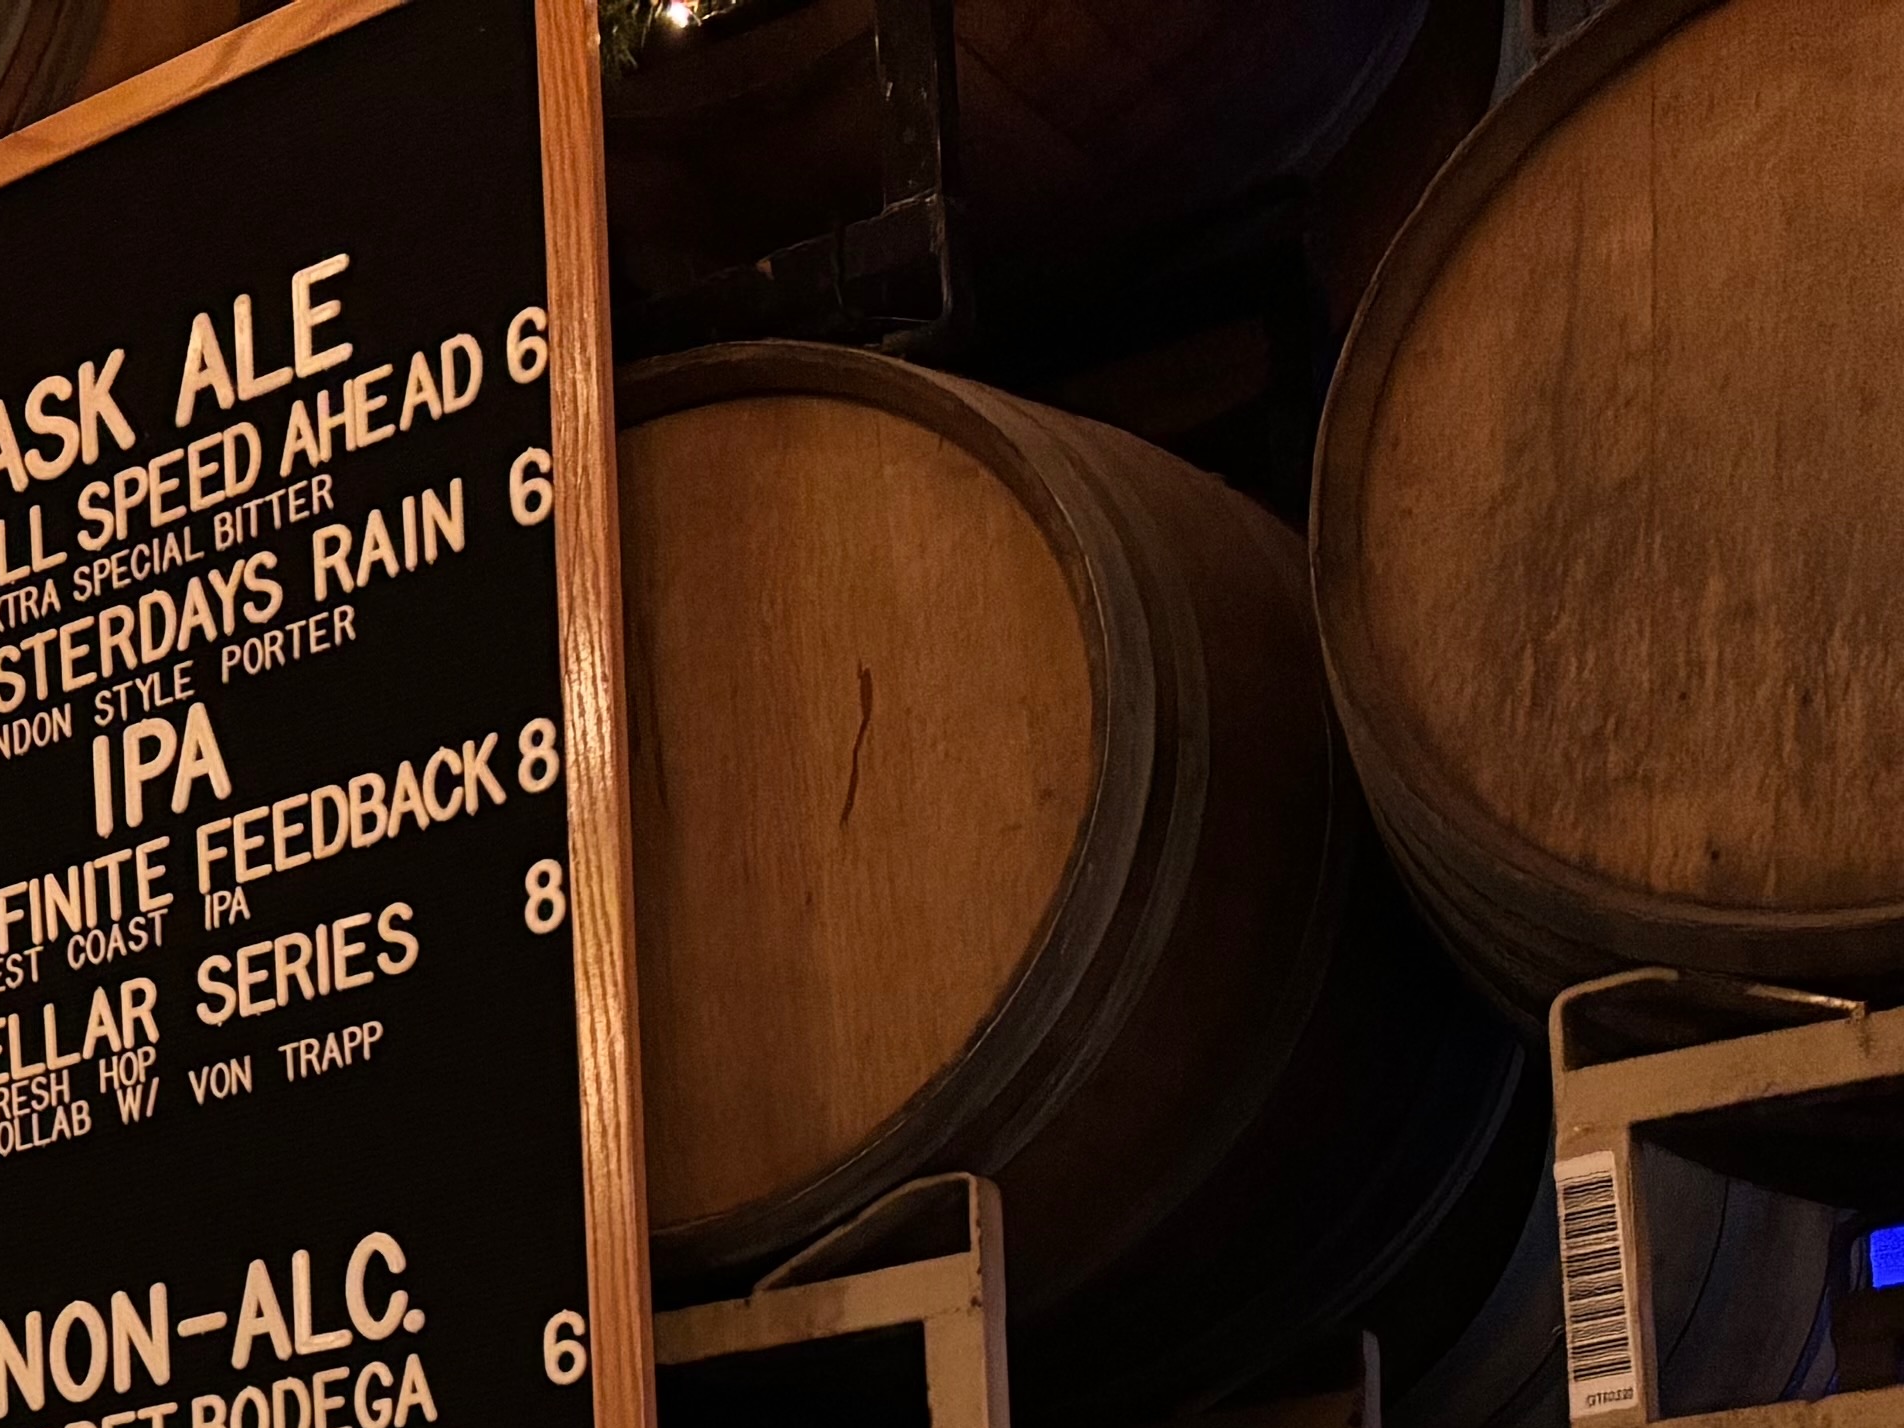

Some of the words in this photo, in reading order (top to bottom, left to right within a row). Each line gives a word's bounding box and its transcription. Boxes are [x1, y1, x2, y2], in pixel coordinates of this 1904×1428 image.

[175, 252, 353, 427] ALE
[77, 421, 262, 552] SPEED
[279, 333, 483, 478] AHEAD
[506, 306, 549, 384] 6
[73, 526, 204, 601] SPECIAL
[213, 473, 334, 551] BITTER
[312, 477, 466, 601] RAIN
[509, 446, 553, 527] 6
[94, 661, 194, 728] STYLE
[221, 604, 356, 684] PORTER
[93, 701, 232, 838] IPA
[195, 732, 507, 895] FEEDBACK
[517, 716, 559, 795] 8
[66, 908, 168, 971] COAST
[203, 885, 251, 932] IPA
[195, 901, 419, 1028] SERIES
[524, 858, 566, 934] 8
[99, 1045, 157, 1095] HOP
[115, 1077, 160, 1126] W/
[188, 1055, 253, 1106] VON
[277, 1021, 385, 1082] TRAPP
[542, 1309, 587, 1387] 6
